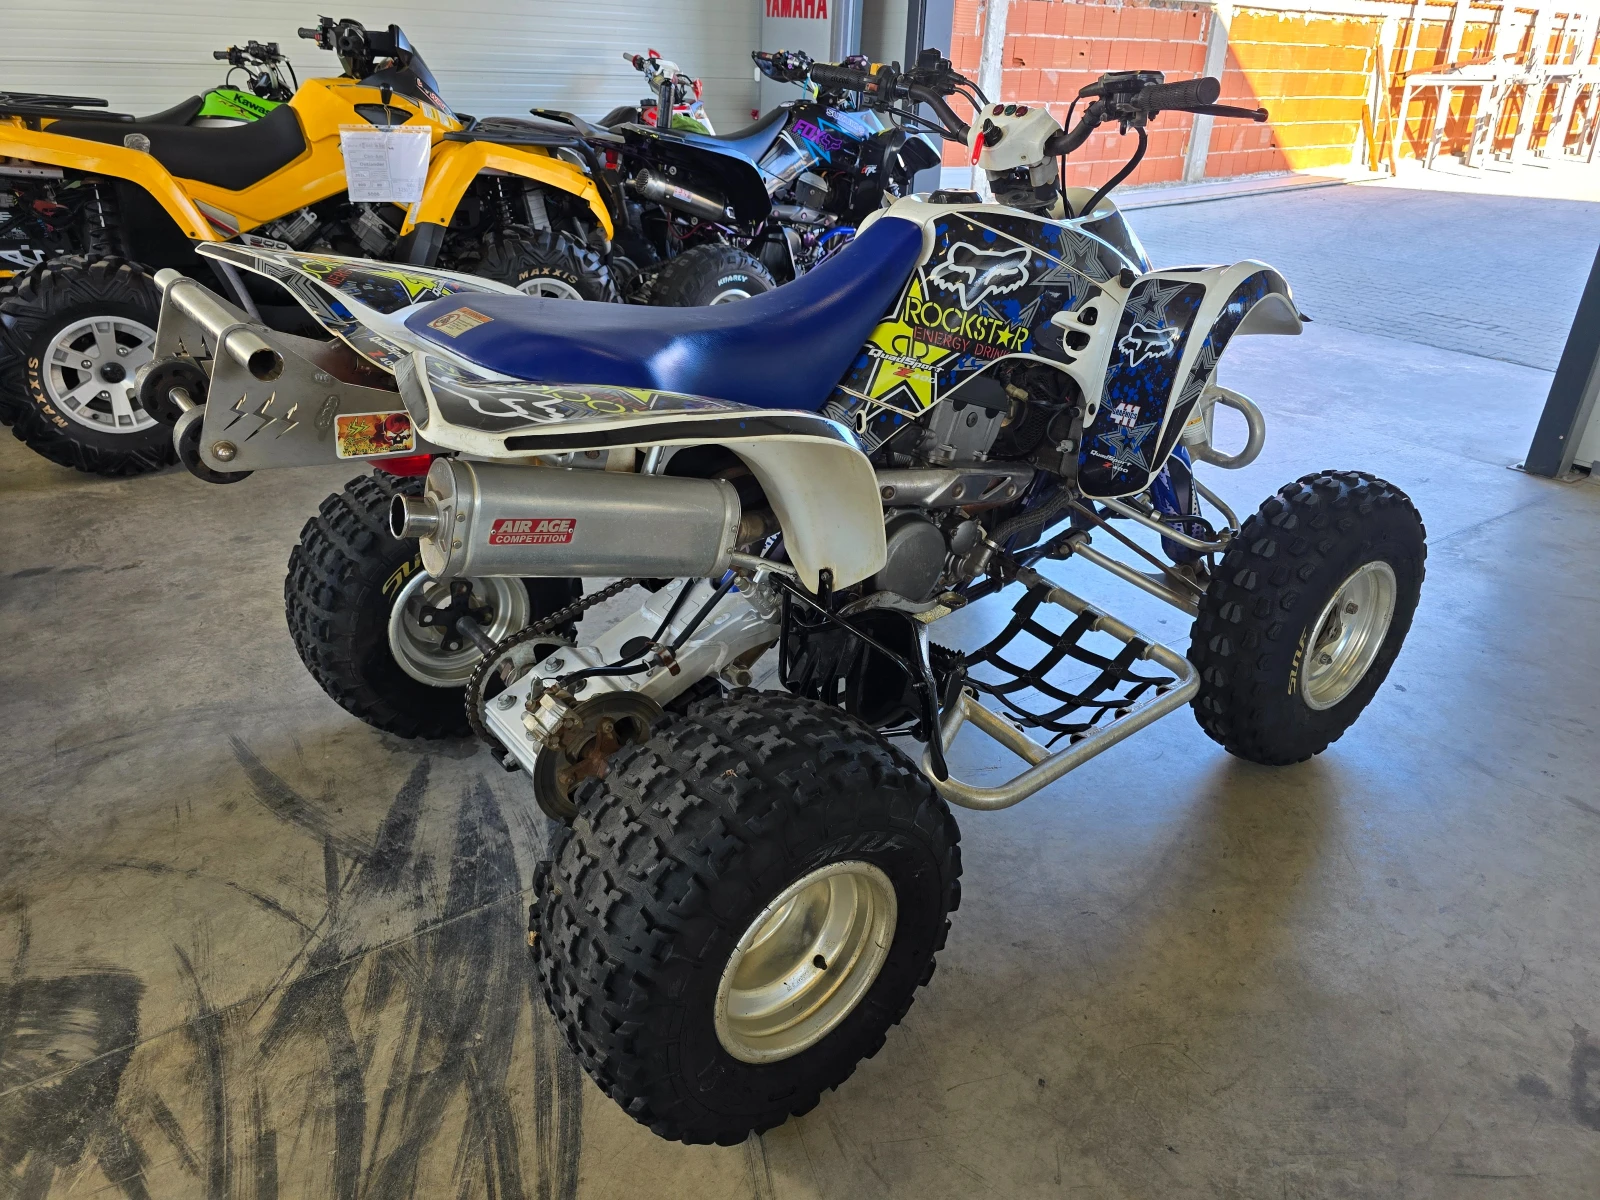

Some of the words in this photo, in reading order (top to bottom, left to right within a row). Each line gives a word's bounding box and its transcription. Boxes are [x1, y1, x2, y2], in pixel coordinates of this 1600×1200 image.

[766, 0, 828, 20] YAMAHA
[233, 93, 271, 115] Kawas
[792, 119, 826, 145] FOX
[518, 266, 579, 284] MAXXIS
[913, 325, 971, 352] ENERGY
[867, 349, 944, 373] QuadSport
[28, 356, 69, 428] MAXXIS
[1090, 449, 1132, 466] QuadSport
[498, 520, 533, 533] AIR
[535, 519, 571, 533] AGE
[495, 534, 567, 543] COMPETITION
